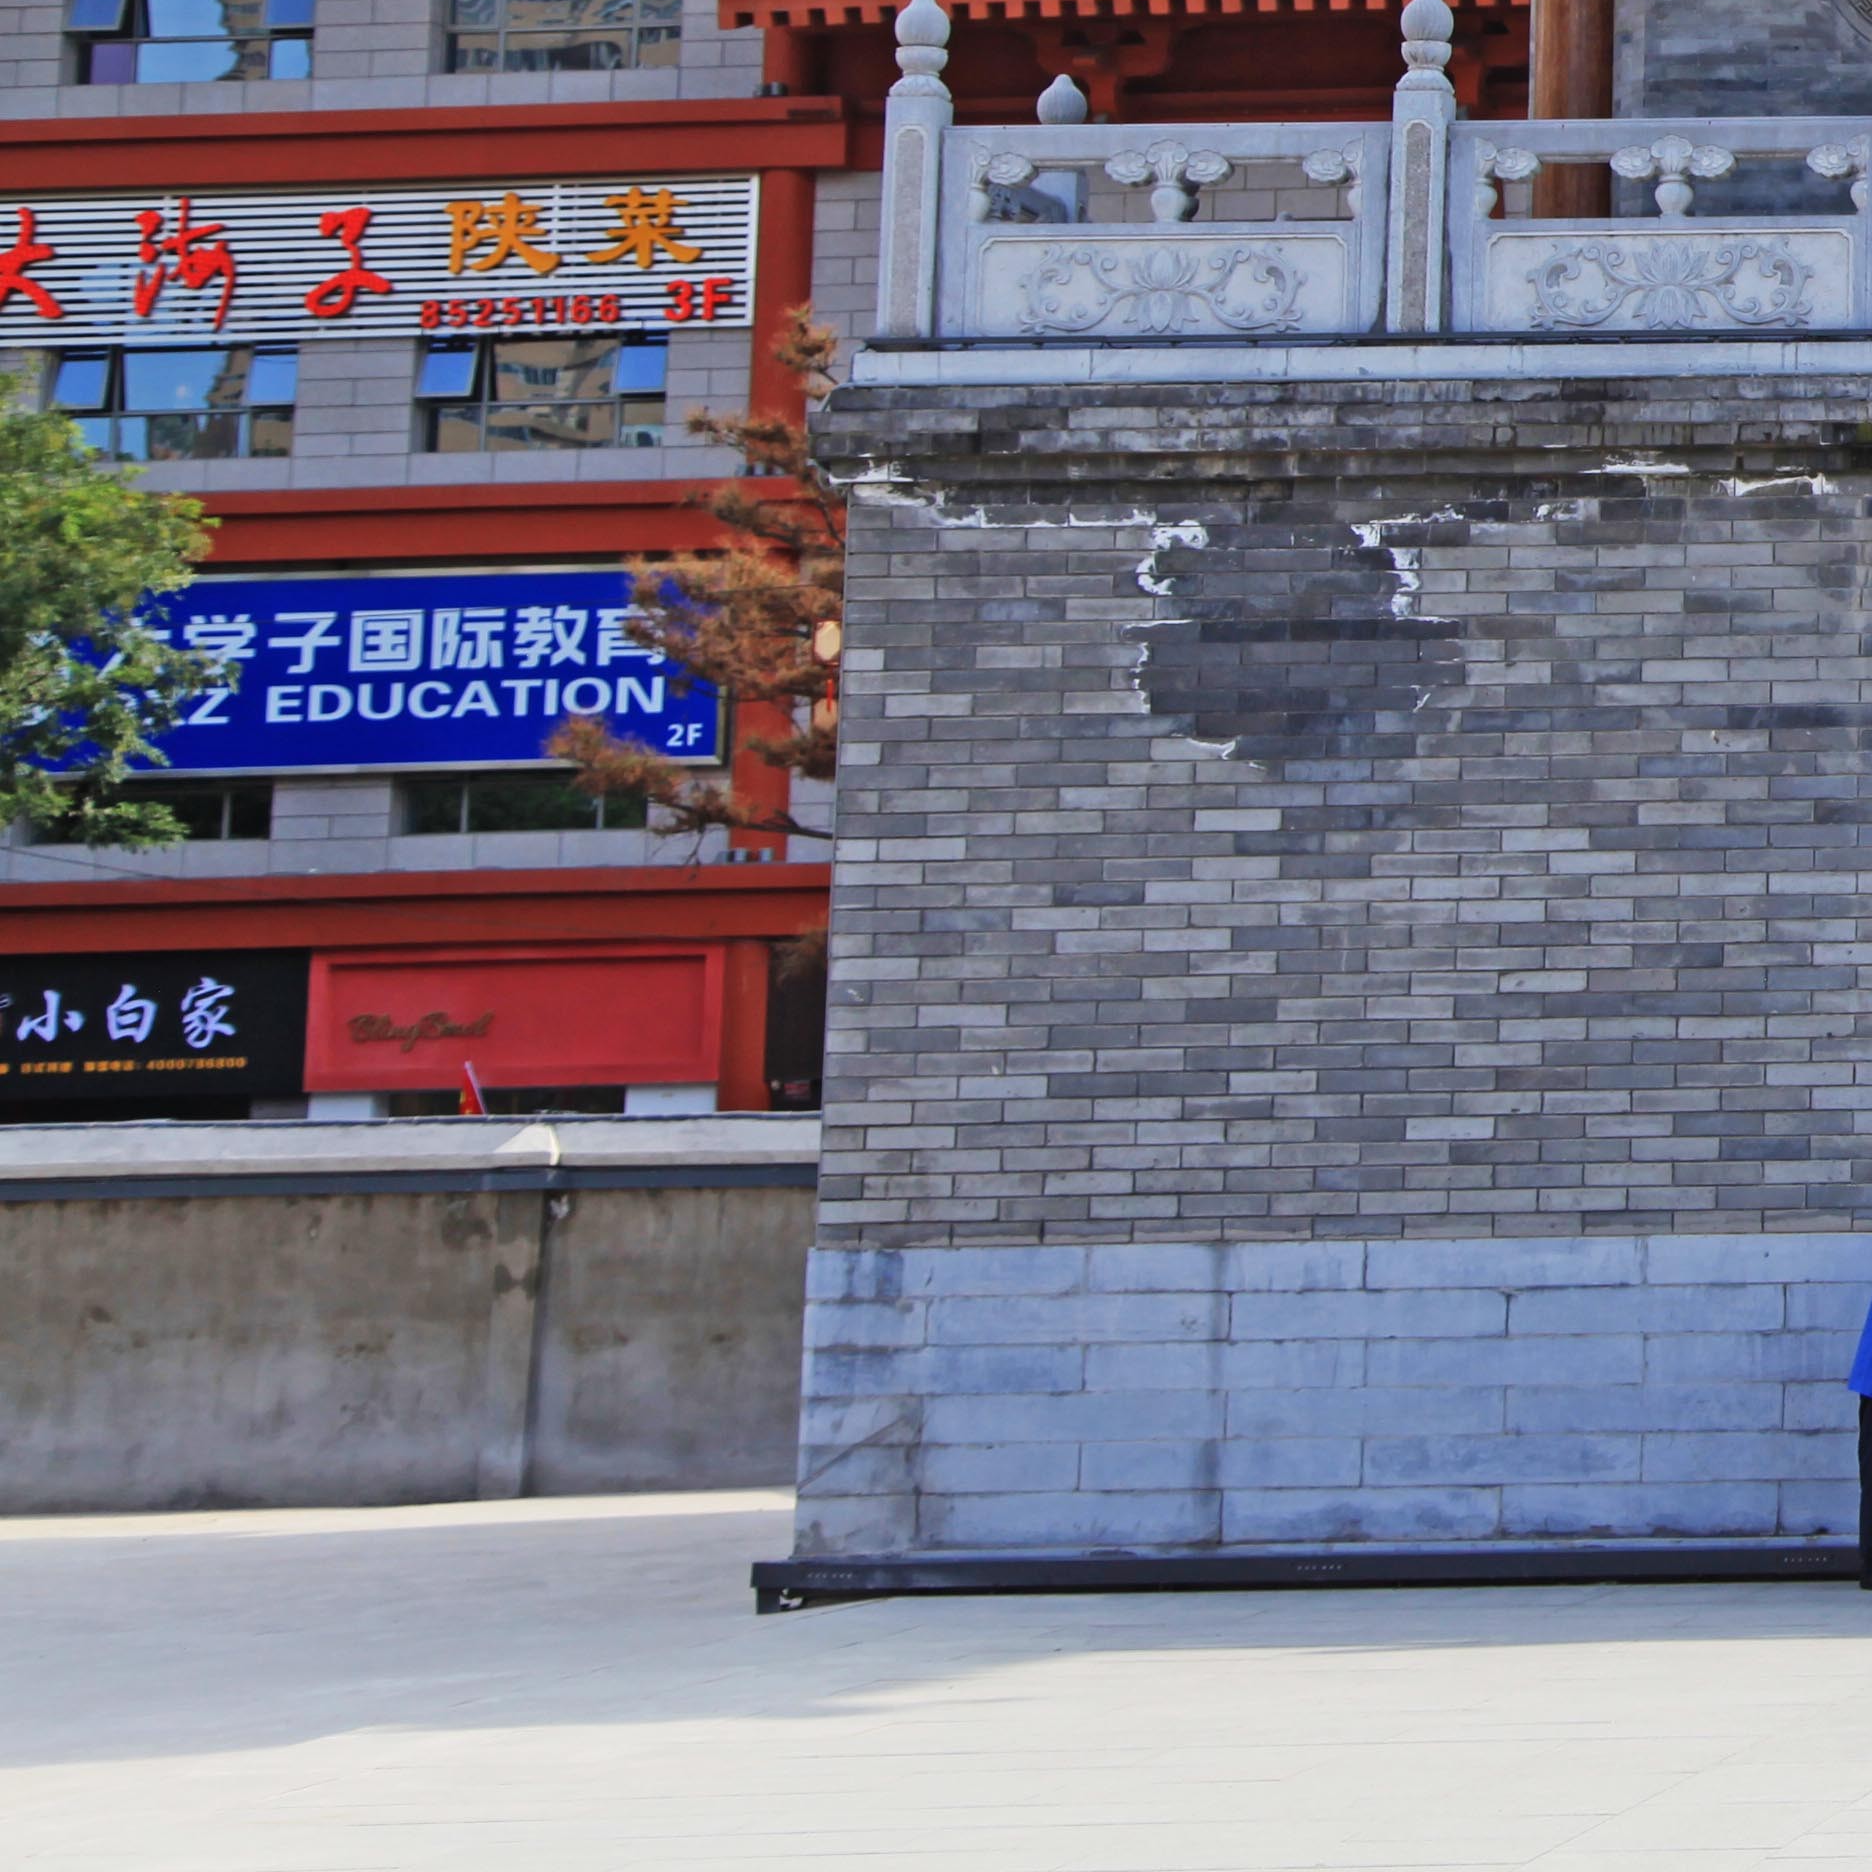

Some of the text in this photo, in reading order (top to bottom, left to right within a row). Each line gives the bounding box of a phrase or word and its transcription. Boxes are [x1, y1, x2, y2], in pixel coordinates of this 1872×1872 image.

[443, 186, 703, 275] 陕菜
[420, 277, 734, 328] 85251166 3F
[265, 676, 666, 723] EDUCATION
[666, 723, 703, 747] 2F
[16, 976, 237, 1049] 小白家
